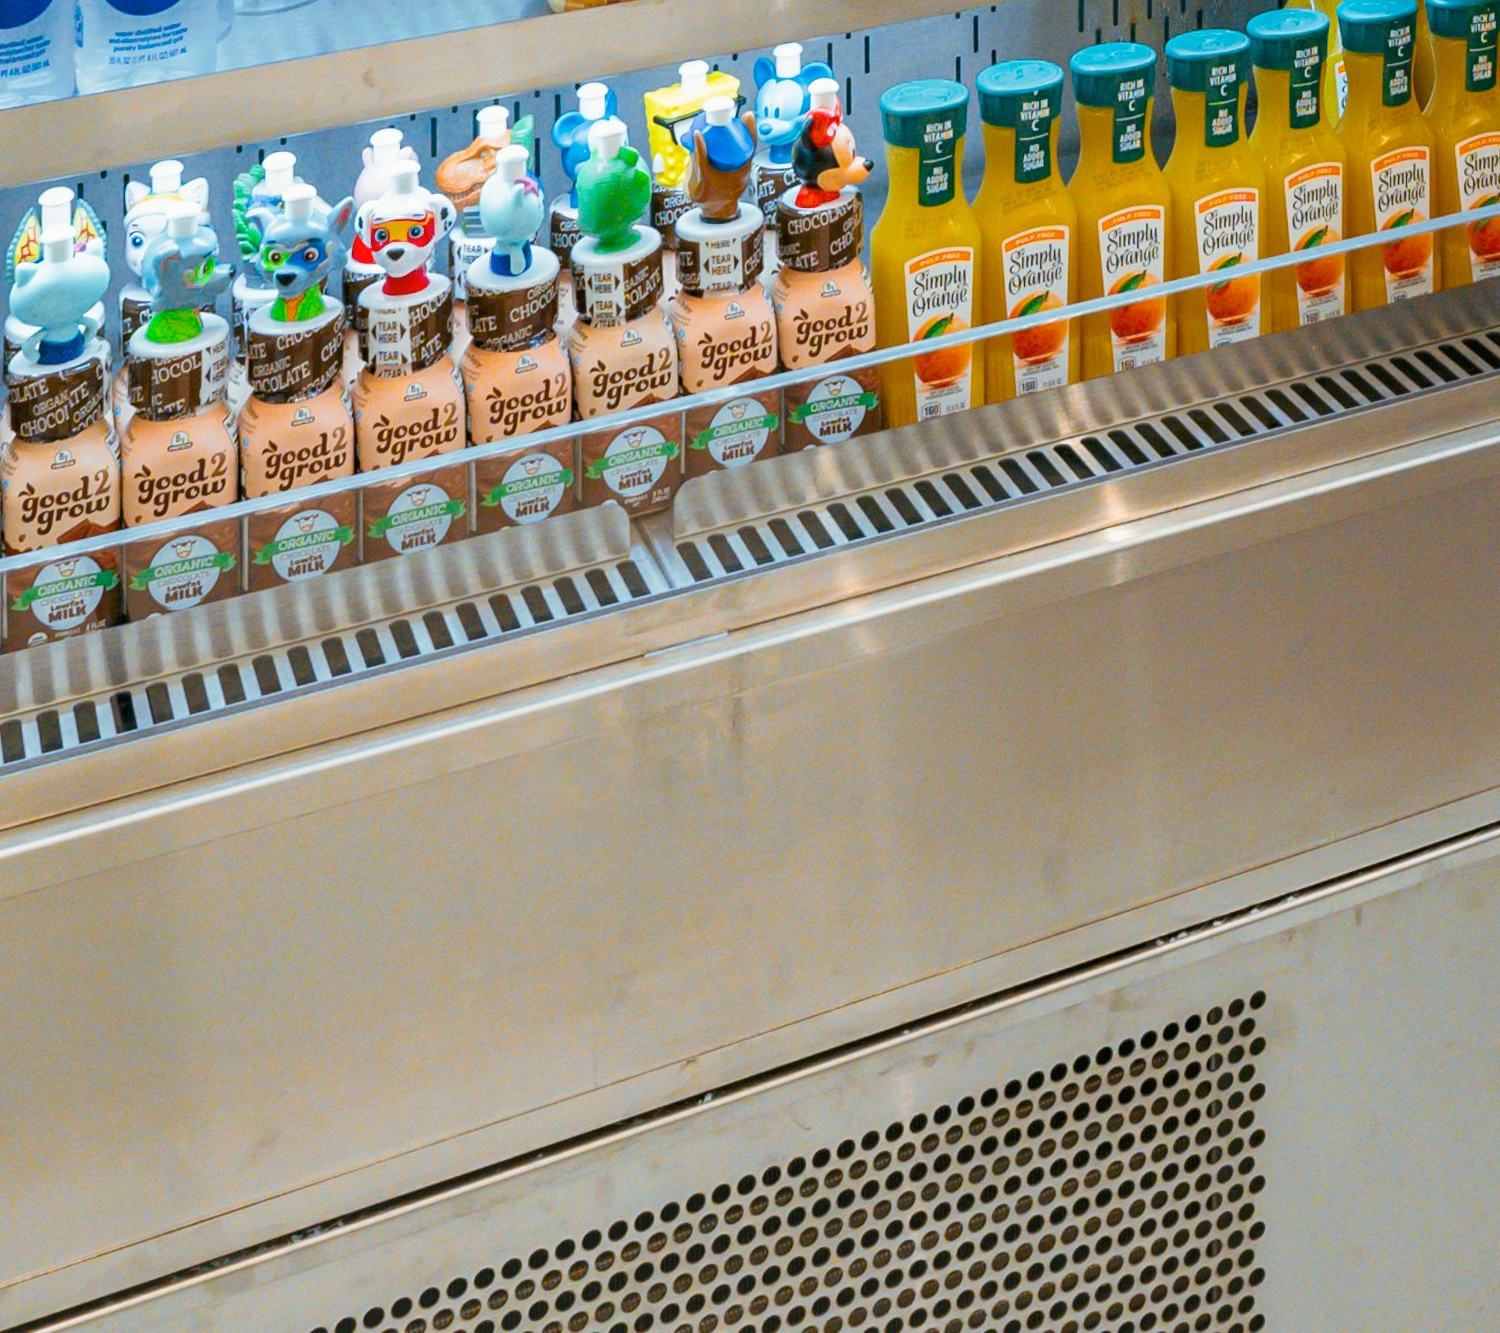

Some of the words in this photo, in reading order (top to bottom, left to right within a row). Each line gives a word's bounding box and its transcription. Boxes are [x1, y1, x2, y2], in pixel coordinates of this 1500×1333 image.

[1020, 107, 1050, 121] VITAMIN
[1022, 100, 1039, 111] RICH
[1040, 99, 1048, 108] IN
[1031, 119, 1039, 131] C
[1029, 144, 1040, 153] NO
[1293, 180, 1339, 211] Simply
[1204, 208, 1253, 240] Simply
[1292, 199, 1339, 229] Orange
[1202, 227, 1254, 256] Orange
[1009, 244, 1062, 275] Simply
[594, 273, 613, 283] TEAR
[913, 265, 967, 297] Simply
[1008, 263, 1063, 296] Orange
[912, 285, 968, 317] Orange
[797, 306, 853, 344] good
[855, 301, 868, 324] 2
[809, 320, 868, 356] grow
[376, 409, 441, 453] good
[443, 402, 458, 427] 2
[391, 427, 457, 463] grow
[21, 476, 89, 523] good
[94, 468, 111, 493] 2
[37, 493, 110, 535] grow
[37, 575, 97, 596] ORGANIC
[48, 604, 86, 623] MILK
